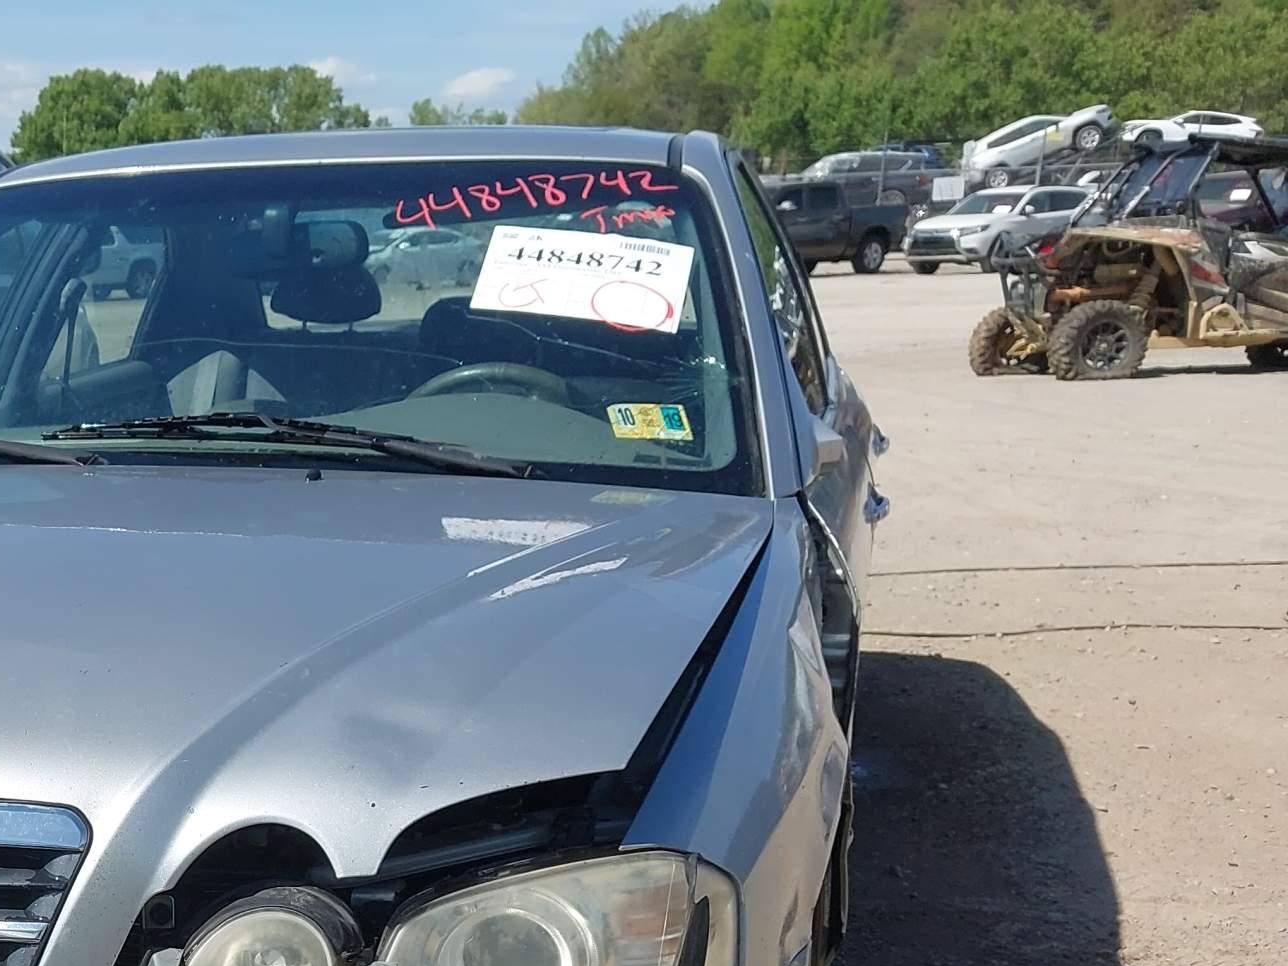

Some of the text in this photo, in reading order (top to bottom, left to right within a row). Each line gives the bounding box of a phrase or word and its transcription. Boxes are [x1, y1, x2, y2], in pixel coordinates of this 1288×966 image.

[394, 169, 680, 230] 44848742
[508, 246, 663, 276] 44848742
[617, 407, 636, 426] 10
